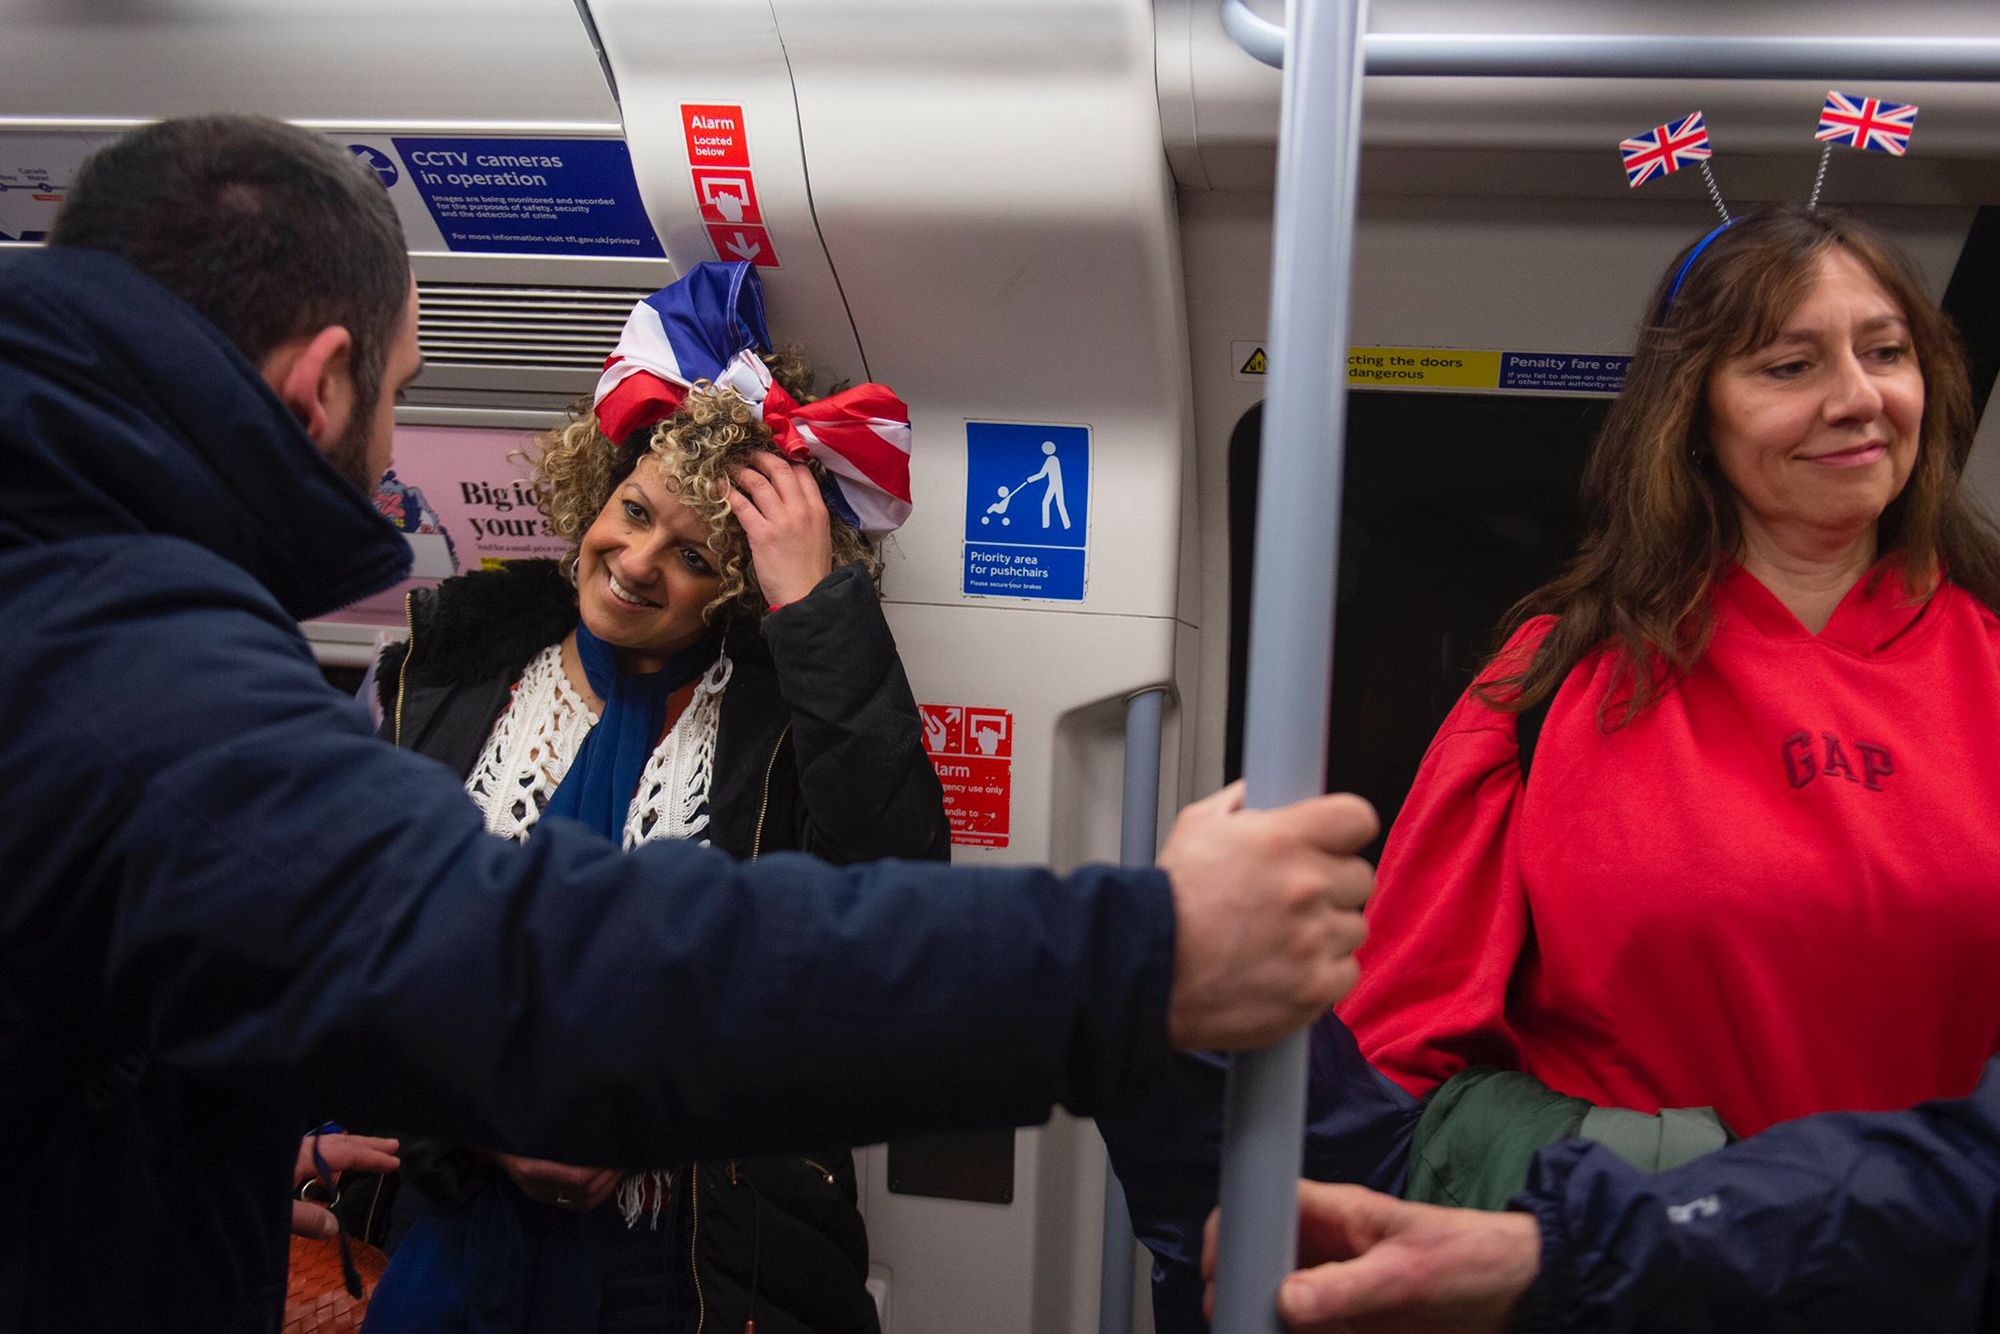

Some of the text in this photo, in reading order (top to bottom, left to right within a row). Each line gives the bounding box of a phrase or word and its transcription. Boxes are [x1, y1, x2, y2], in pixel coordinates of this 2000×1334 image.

[691, 115, 735, 130] Alarm
[693, 135, 733, 146] Located
[695, 147, 726, 157] below
[411, 151, 564, 168] CCTV cameras
[420, 170, 547, 188] in operation
[432, 195, 464, 203] Images
[480, 195, 507, 205] being
[507, 196, 554, 204] monitored
[469, 204, 510, 212] purposes
[452, 232, 466, 240] For
[491, 234, 545, 242] information
[565, 236, 640, 245] tfl.gov.uk/privacy
[1347, 355, 1463, 367] cting the doors
[1510, 356, 1566, 370] Penalty
[1571, 358, 1600, 369] fare
[1605, 362, 1622, 370] or
[1348, 367, 1424, 379] dangerous
[460, 481, 513, 512] Big
[468, 518, 537, 541] your
[970, 551, 1038, 565] Priority area
[970, 564, 1049, 578] for pushchairs
[1781, 730, 1894, 792] GAP
[935, 761, 970, 778] larm
[968, 785, 984, 793] use
[985, 786, 1003, 796] only
[969, 810, 979, 818] to
